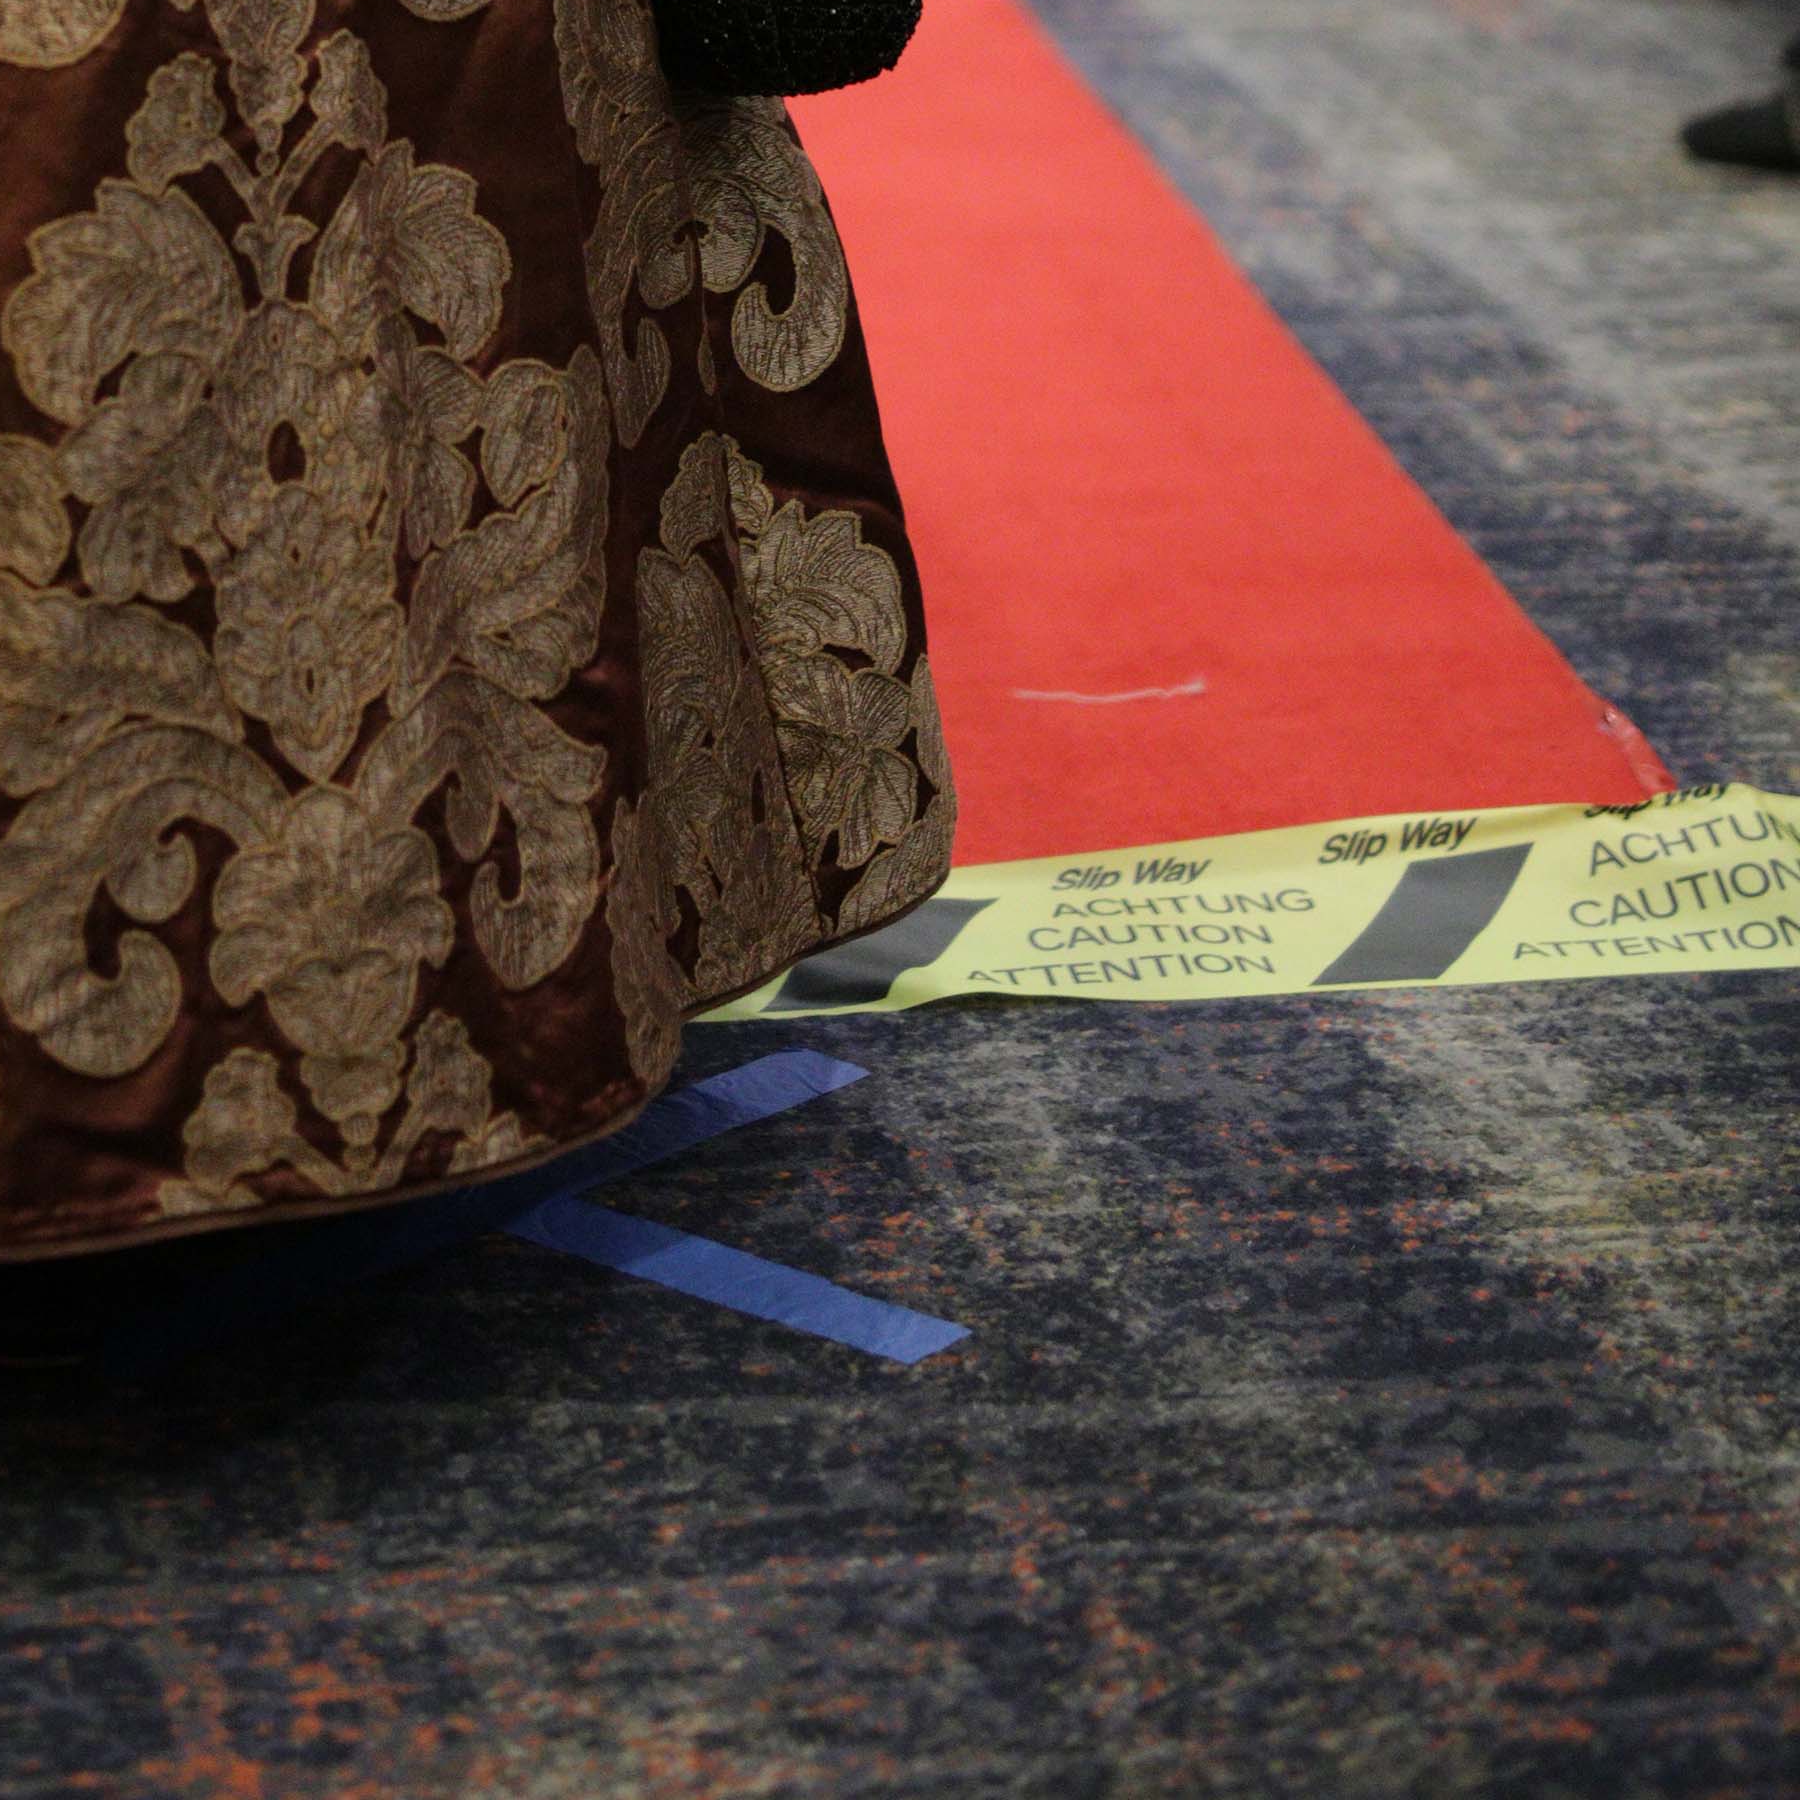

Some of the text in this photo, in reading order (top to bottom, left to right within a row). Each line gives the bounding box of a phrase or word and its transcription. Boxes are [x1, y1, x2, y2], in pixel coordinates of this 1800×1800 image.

[1318, 816, 1479, 865] Slip Way
[1051, 857, 1212, 891] Slip Way
[1052, 888, 1316, 919] ACHTUNG
[1028, 923, 1275, 951] CAUTION
[967, 953, 1277, 987] ATTENTION
